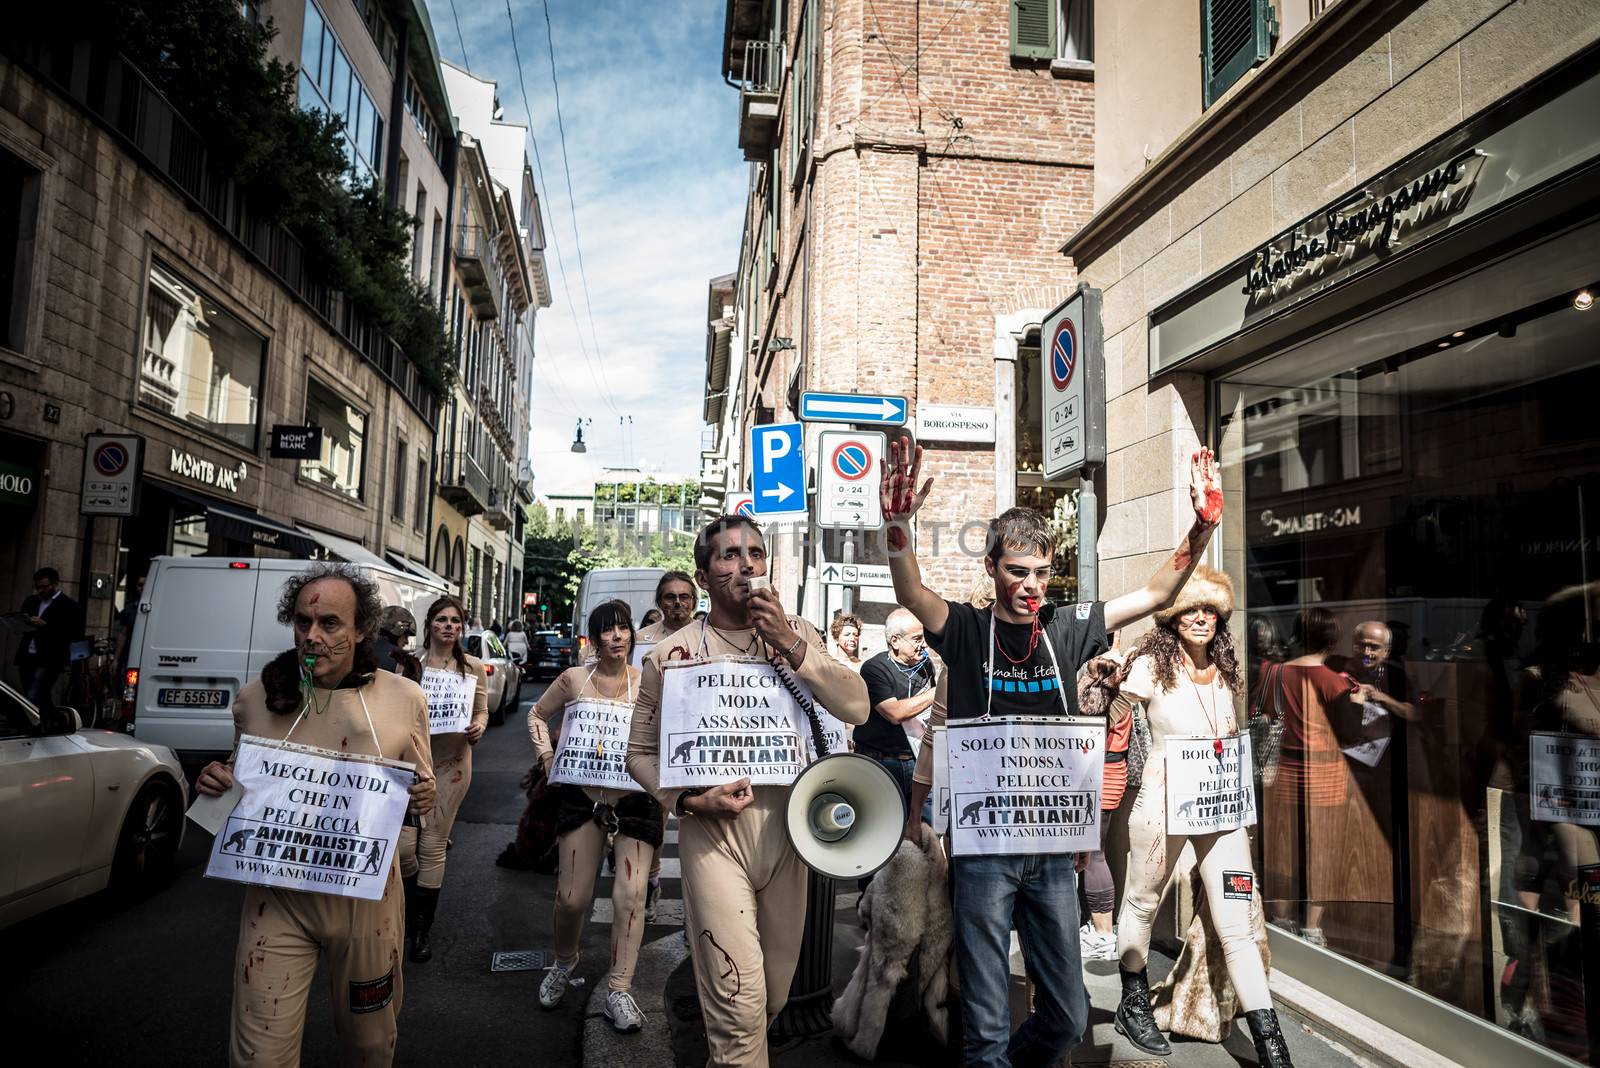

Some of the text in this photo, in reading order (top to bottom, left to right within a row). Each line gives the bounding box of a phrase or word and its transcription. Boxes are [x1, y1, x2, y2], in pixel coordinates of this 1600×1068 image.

[923, 420, 989, 430] BORGOSPESSO
[280, 433, 307, 443] MONT
[280, 441, 306, 450] BLANC
[762, 431, 791, 473] P
[170, 448, 237, 493] MONTBANC
[158, 655, 198, 663] TRANSIT
[697, 674, 786, 689] PELLICCIA
[718, 694, 770, 709] MODA
[697, 714, 791, 729] ASSASSINA
[579, 724, 620, 737] VENDE
[567, 736, 628, 751] PELLCCE
[695, 735, 798, 748] ANIMALISTI
[960, 736, 1096, 752] SOLO UN MOSTRO
[699, 749, 796, 763] ITALIANI
[1000, 755, 1065, 769] INDOSSA
[258, 759, 391, 795] MEGLIO NUDI
[995, 774, 1071, 788] PELLICCE
[287, 787, 352, 812] CHE IN
[984, 794, 1084, 808] ANIMALISTI
[262, 806, 362, 835] PELLICCIA
[988, 809, 1080, 825] ITALIANI
[255, 825, 369, 853] ANIMALISTI
[976, 826, 1086, 839] WWW.ANIMALISTI.IT
[254, 841, 359, 871] ITALIANI
[234, 859, 361, 888] WWW.ANIMALISTI.IT
